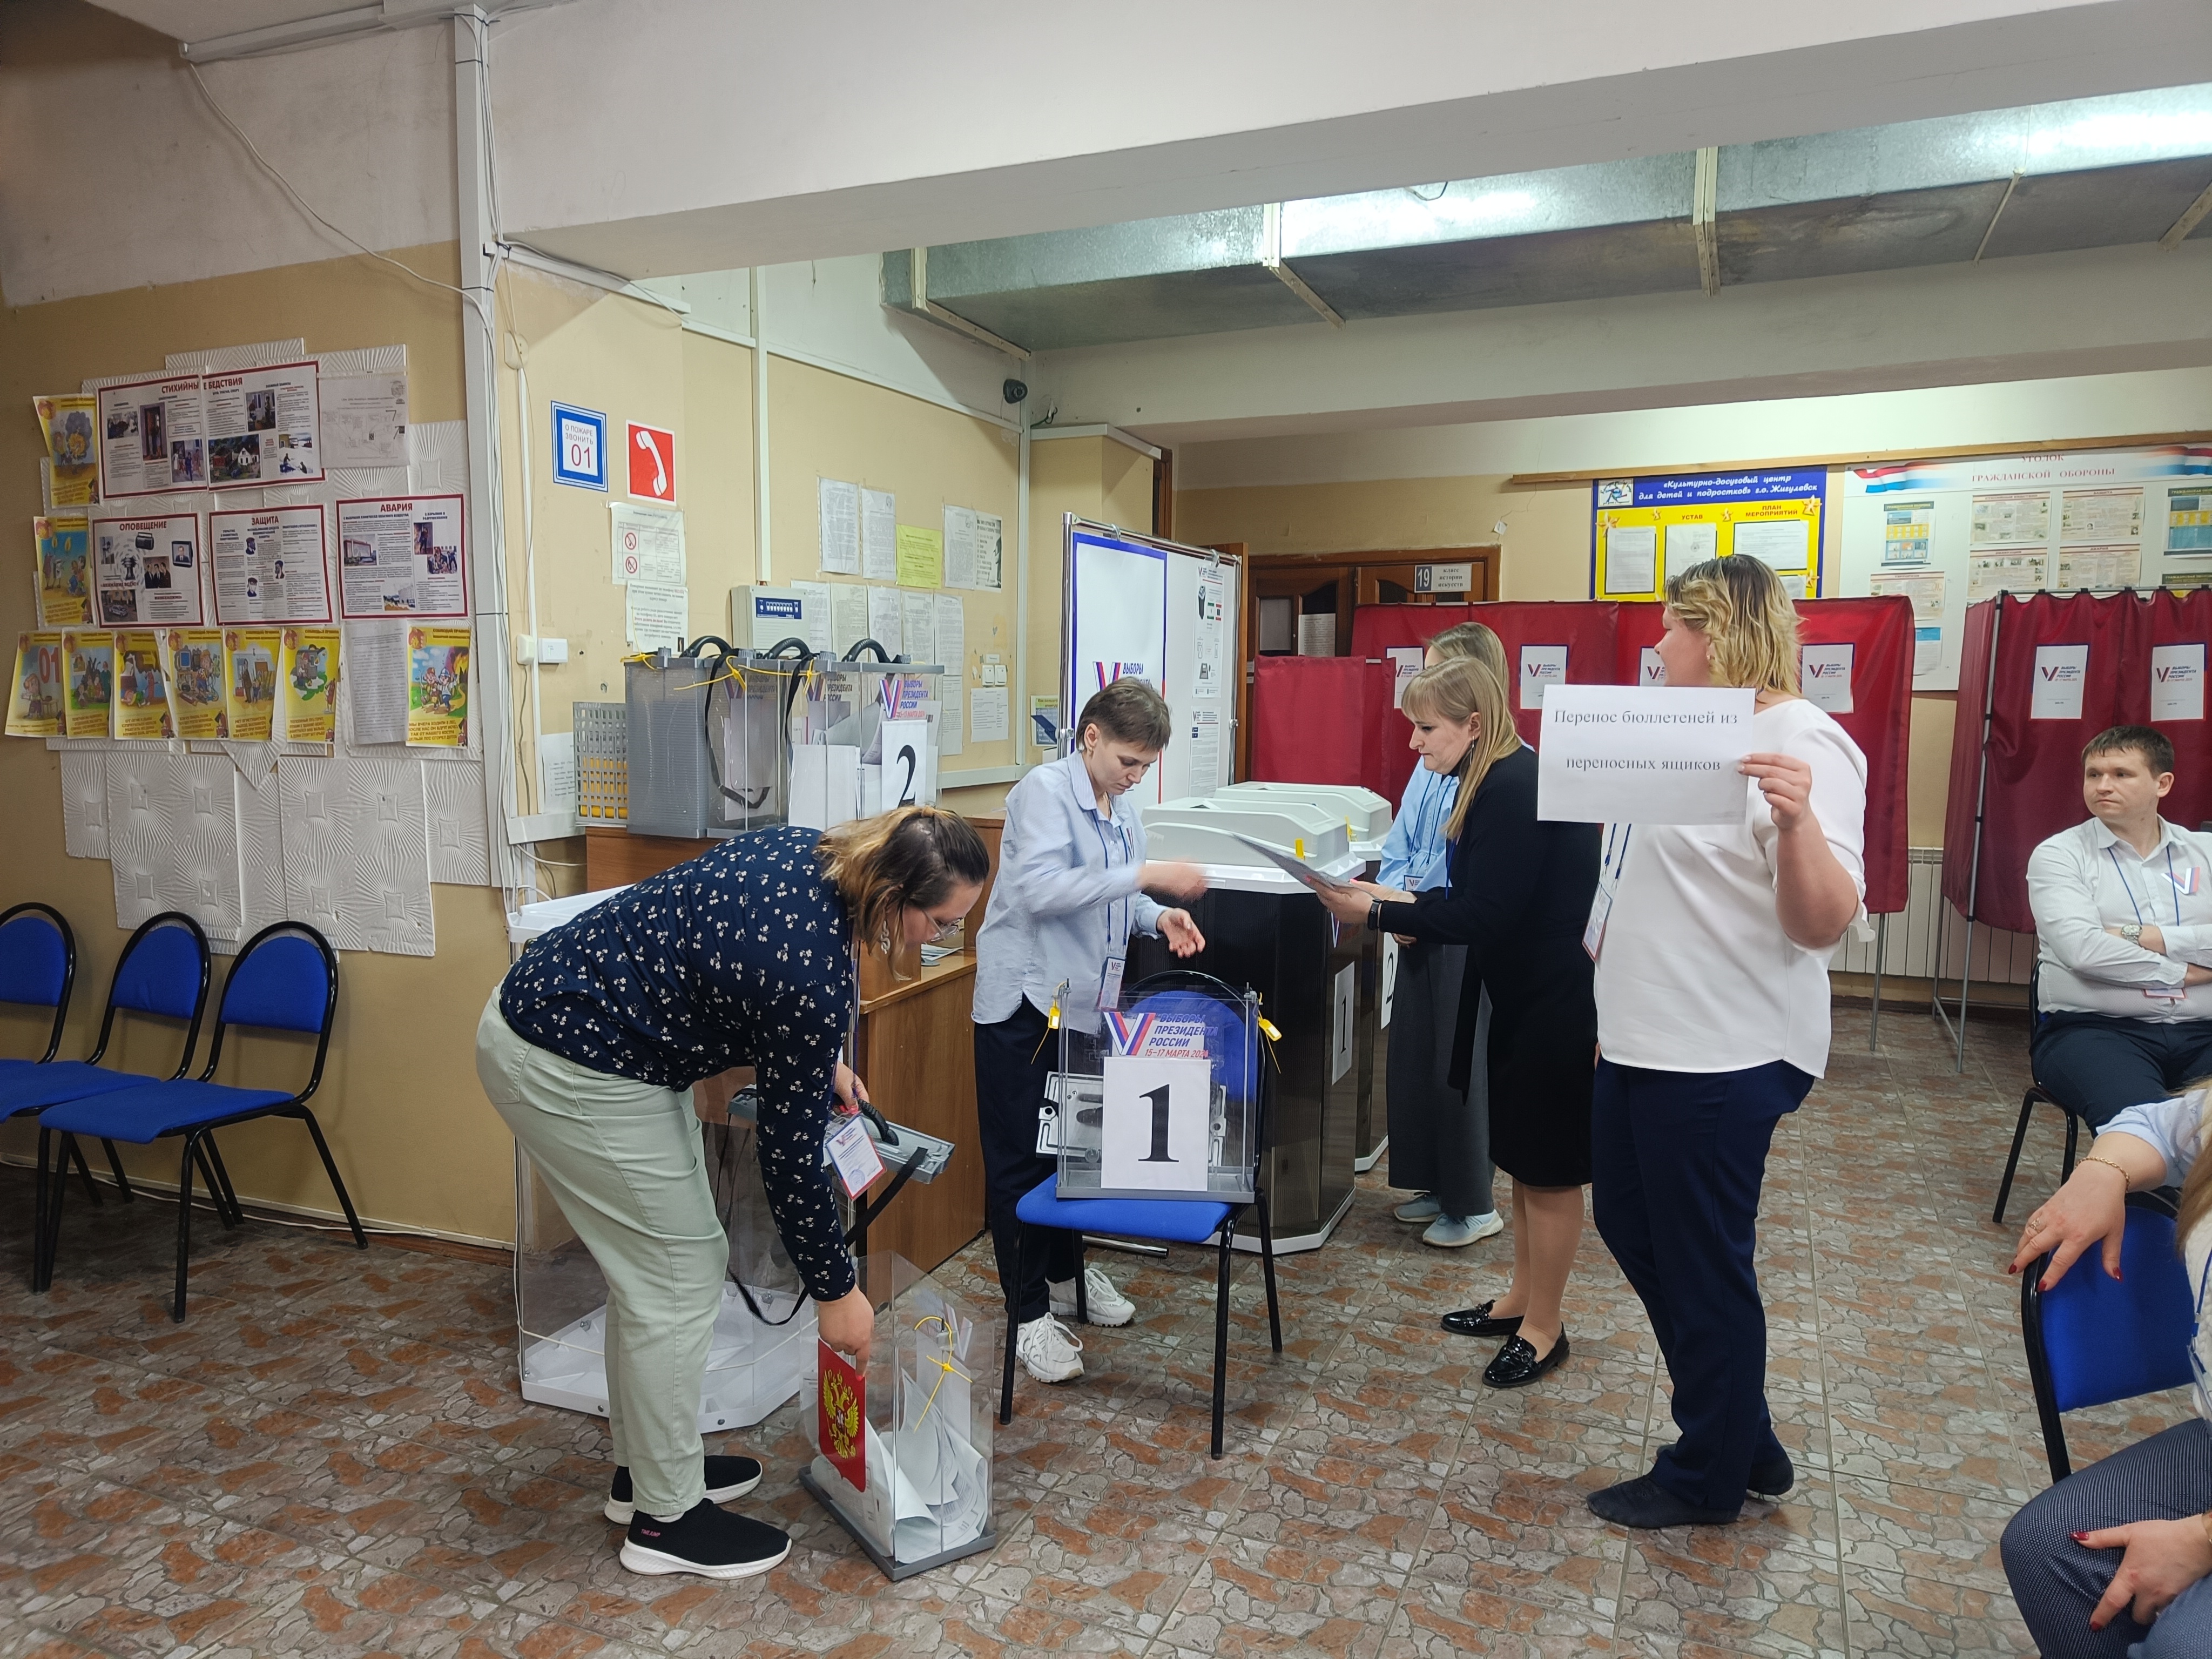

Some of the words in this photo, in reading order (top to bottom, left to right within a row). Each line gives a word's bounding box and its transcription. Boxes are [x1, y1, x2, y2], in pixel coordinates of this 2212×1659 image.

[208, 377, 242, 389] БЕДСТВИЯ
[571, 425, 593, 436] ПОЖАРЕ
[565, 433, 593, 444] ЗВОНИТЬ
[571, 444, 590, 468] 01
[2021, 454, 2065, 462] УГОЛОК
[1972, 469, 2051, 482] ГРАЖДАНСКОЙ
[2060, 468, 2115, 478] ОБОРОНЫ
[1663, 476, 1758, 489] «Культурно-досуговый
[1657, 491, 1683, 499] детей
[1697, 487, 1751, 498] подростков»
[1770, 483, 1817, 493] Жигулевск
[380, 503, 413, 512] АВАРИЯ
[119, 521, 167, 531] ОПОВЕЩЕНИЕ
[251, 516, 279, 525] ЗАЩИТА
[1418, 569, 1430, 587] 19
[39, 646, 60, 684] 01
[1123, 663, 1144, 675] ВЫБОРЫ
[904, 680, 923, 688] ВЫБОРЫ
[902, 690, 928, 699] ПРЕЗИДЕНТА
[900, 701, 918, 709] РОССИИ
[1555, 710, 1617, 726] Перенос
[1622, 710, 1715, 724] бюллетеней
[1721, 716, 1737, 724] из
[1567, 758, 1656, 772] переносных
[1662, 762, 1721, 771] ящиков
[896, 745, 916, 808] 2
[1386, 952, 1394, 1004] 2
[1159, 1013, 1206, 1024] ВЫБОРЫ
[1340, 995, 1347, 1054] 1
[1154, 1026, 1218, 1037] ПРЕЗИДЕНТА
[1149, 1037, 1190, 1047] РОССИИ
[1165, 1049, 1190, 1057] МАРТА
[1191, 1049, 1209, 1058] 2024
[1138, 1084, 1179, 1163] 1
